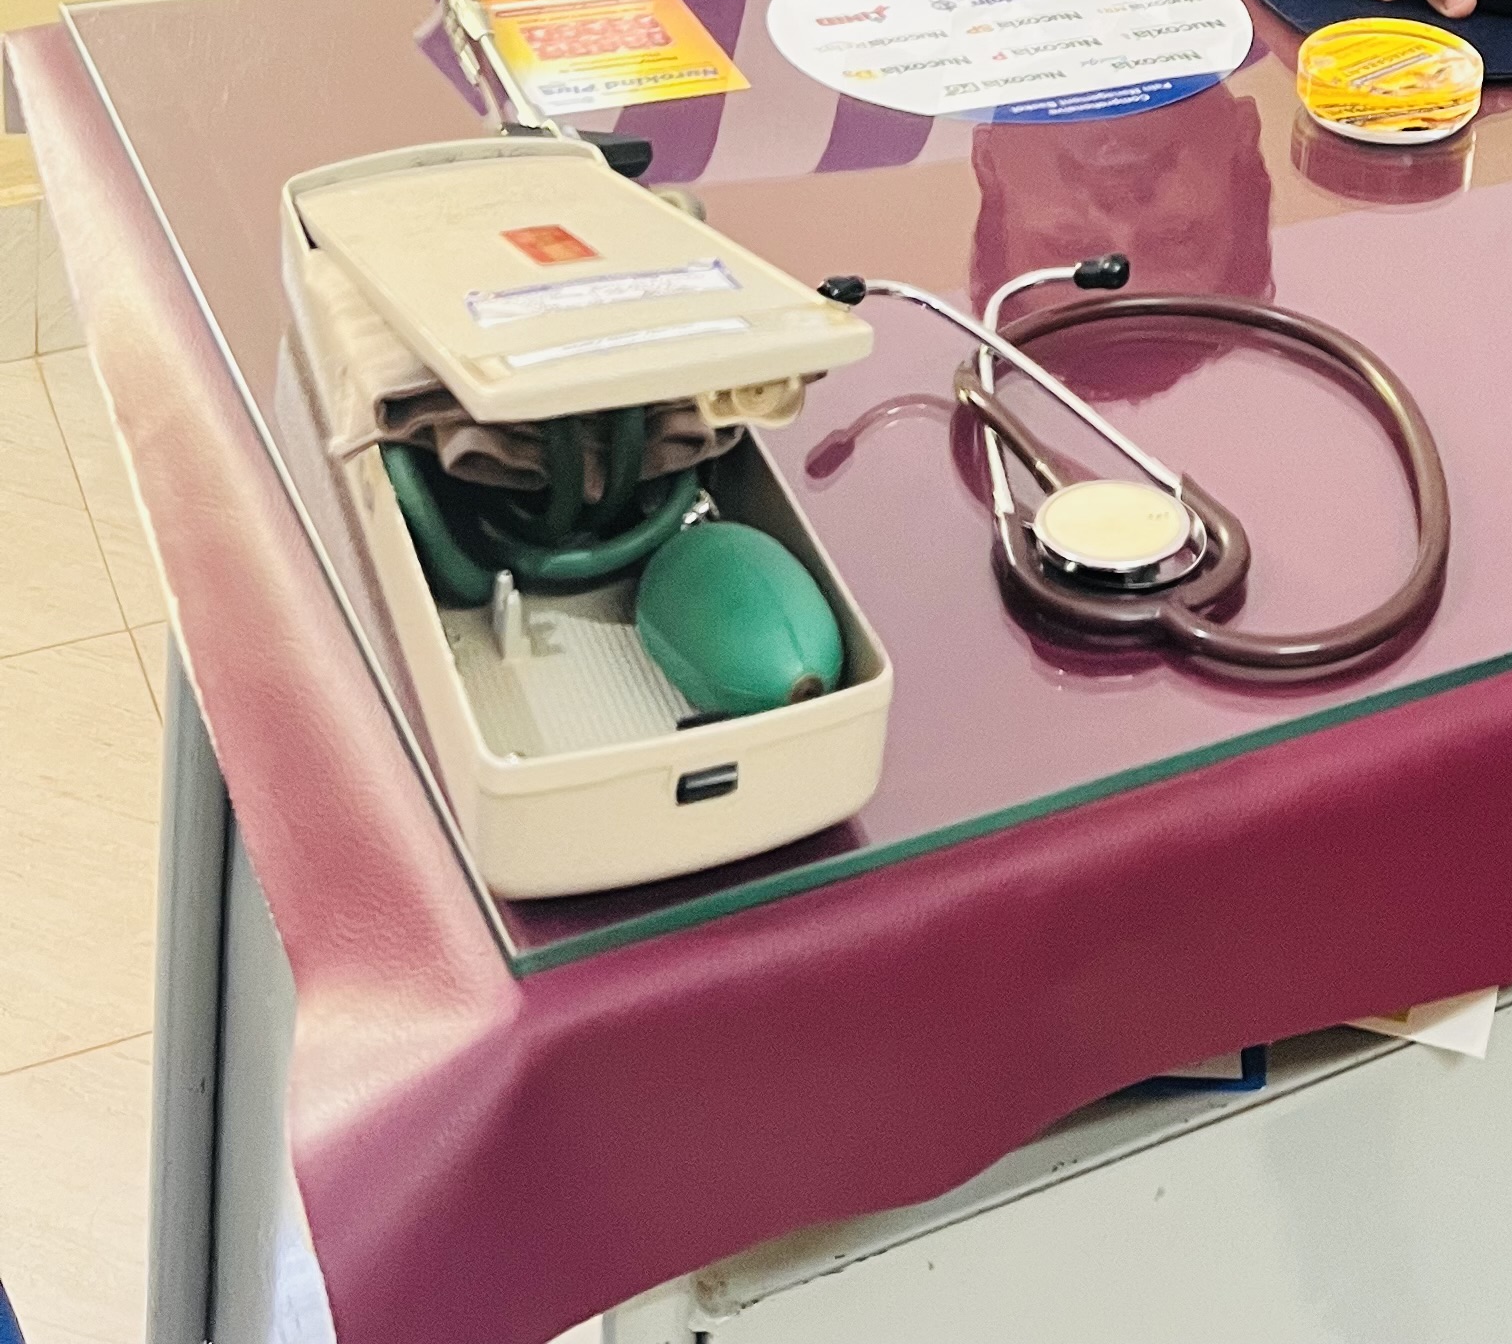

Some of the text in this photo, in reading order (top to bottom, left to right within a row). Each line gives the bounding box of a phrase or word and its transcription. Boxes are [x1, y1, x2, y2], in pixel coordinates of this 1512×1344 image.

[1133, 19, 1225, 40] Nucoxia
[1111, 50, 1202, 71] Nucoxia
[540, 66, 720, 98] Nurokind Plus
